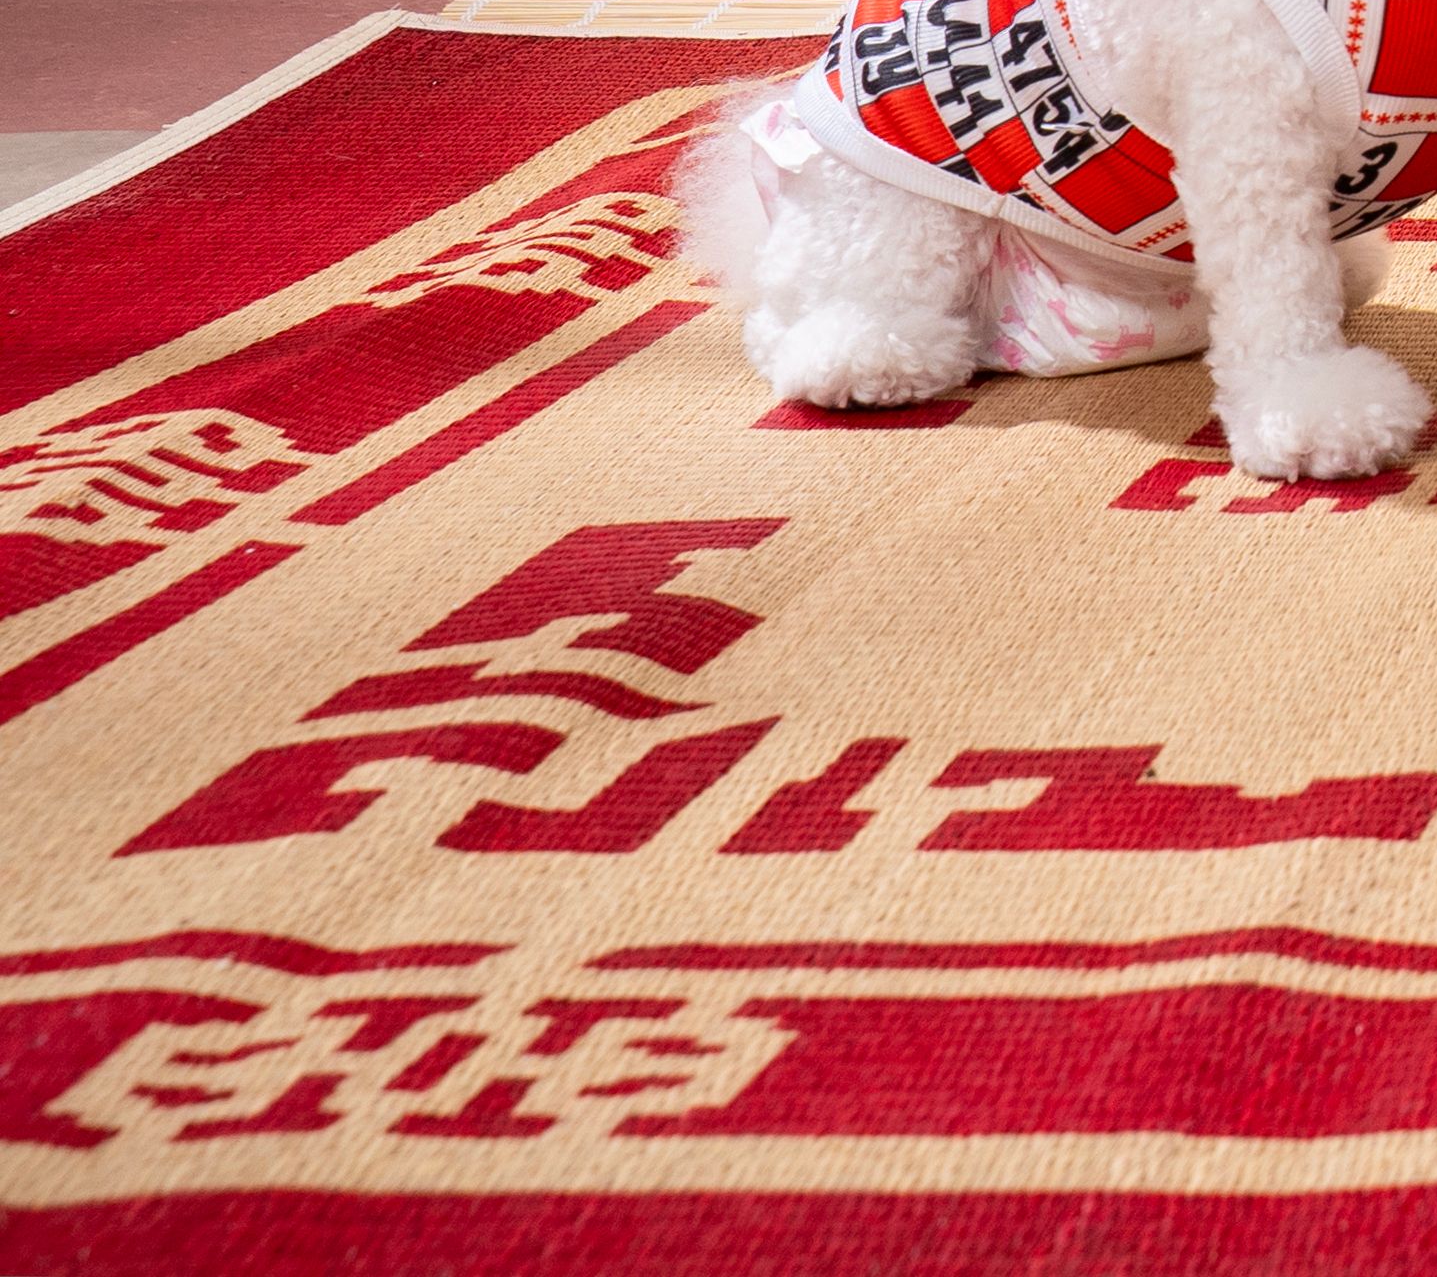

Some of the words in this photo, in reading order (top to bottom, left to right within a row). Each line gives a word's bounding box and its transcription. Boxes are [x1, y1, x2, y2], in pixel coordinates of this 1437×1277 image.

[1002, 20, 1064, 93] 47
[1034, 85, 1098, 177] 54
[1334, 141, 1398, 195] 3
